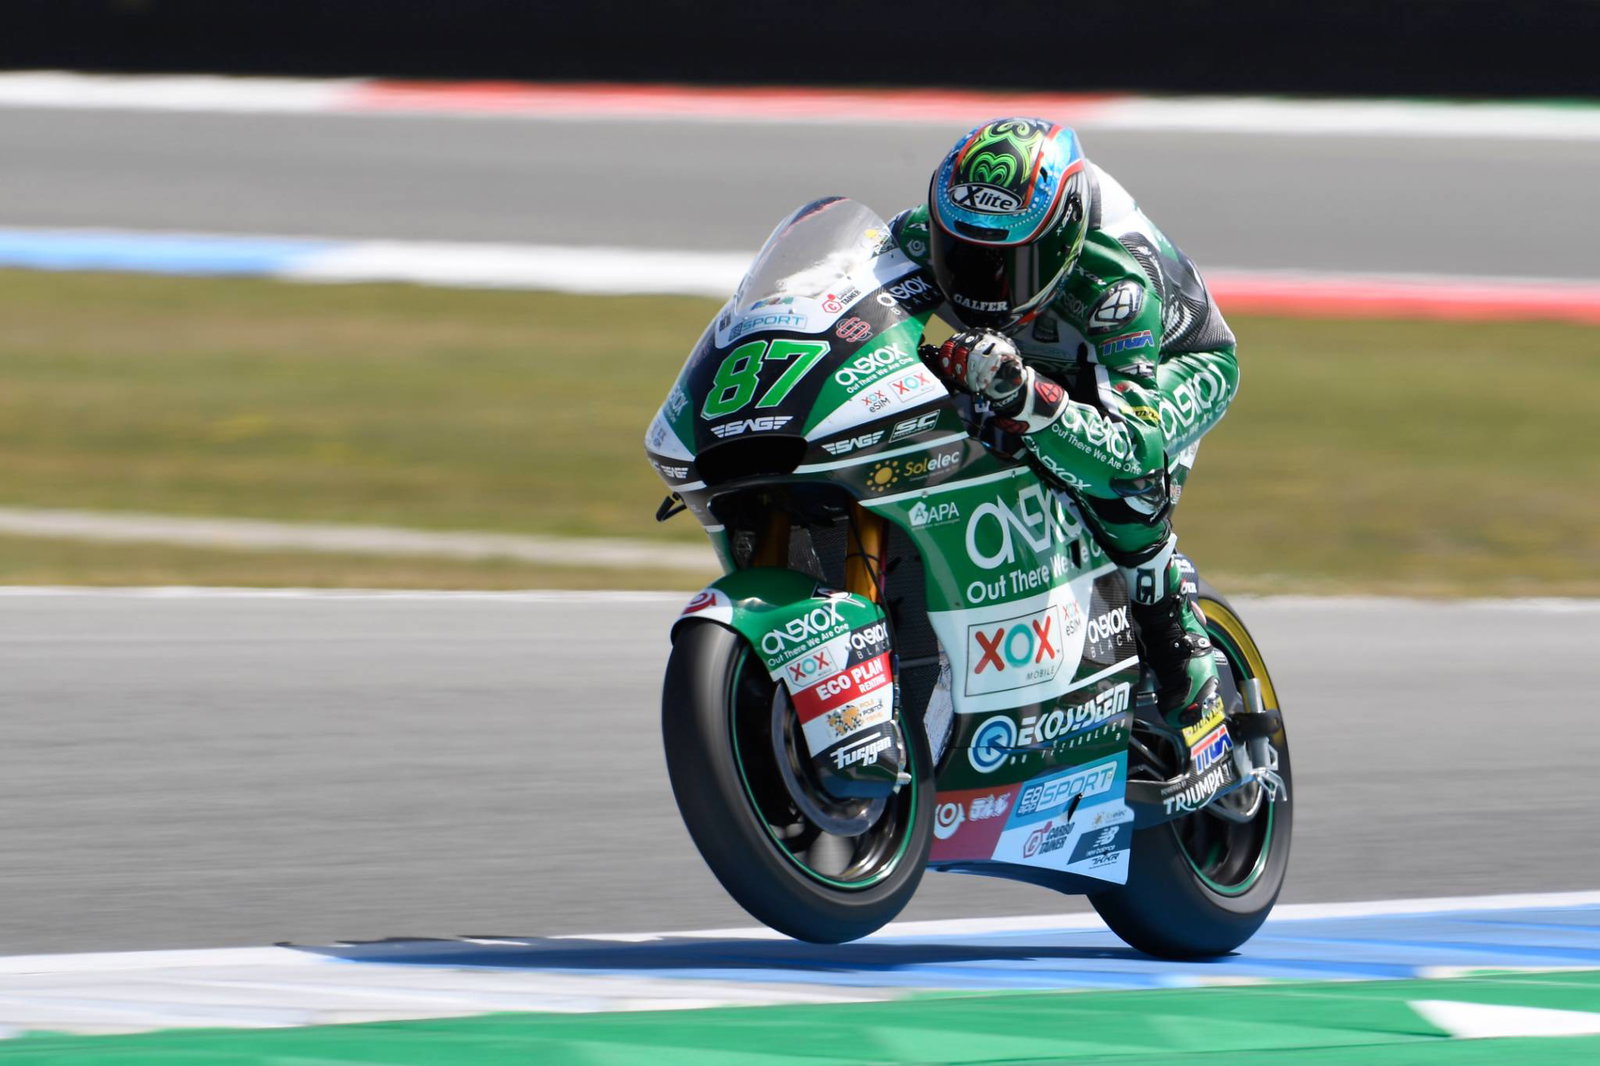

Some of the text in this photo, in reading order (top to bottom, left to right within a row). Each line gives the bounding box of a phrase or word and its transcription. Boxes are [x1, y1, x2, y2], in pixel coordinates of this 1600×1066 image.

[957, 185, 1013, 210] X-lite
[953, 293, 1009, 312] GALFER
[742, 315, 804, 332] SPORT
[701, 339, 831, 420] 87
[892, 372, 930, 395] XOX
[861, 390, 884, 405] XOX
[869, 397, 890, 412] eSIM
[1051, 423, 1142, 475] Out There We Are One
[904, 451, 960, 476] Solelec
[966, 575, 1006, 604] Out
[1010, 564, 1050, 594] There
[1050, 553, 1069, 579] We
[767, 623, 849, 668] Out There We Are One
[974, 615, 1056, 675] XOX
[1090, 630, 1132, 658] BLACK
[788, 652, 830, 681] XOX
[816, 658, 884, 702] ECO PLAN
[1026, 665, 1056, 681] MOBILE
[1040, 771, 1108, 805] SPORT
[1163, 766, 1225, 816] TRIUMPH
